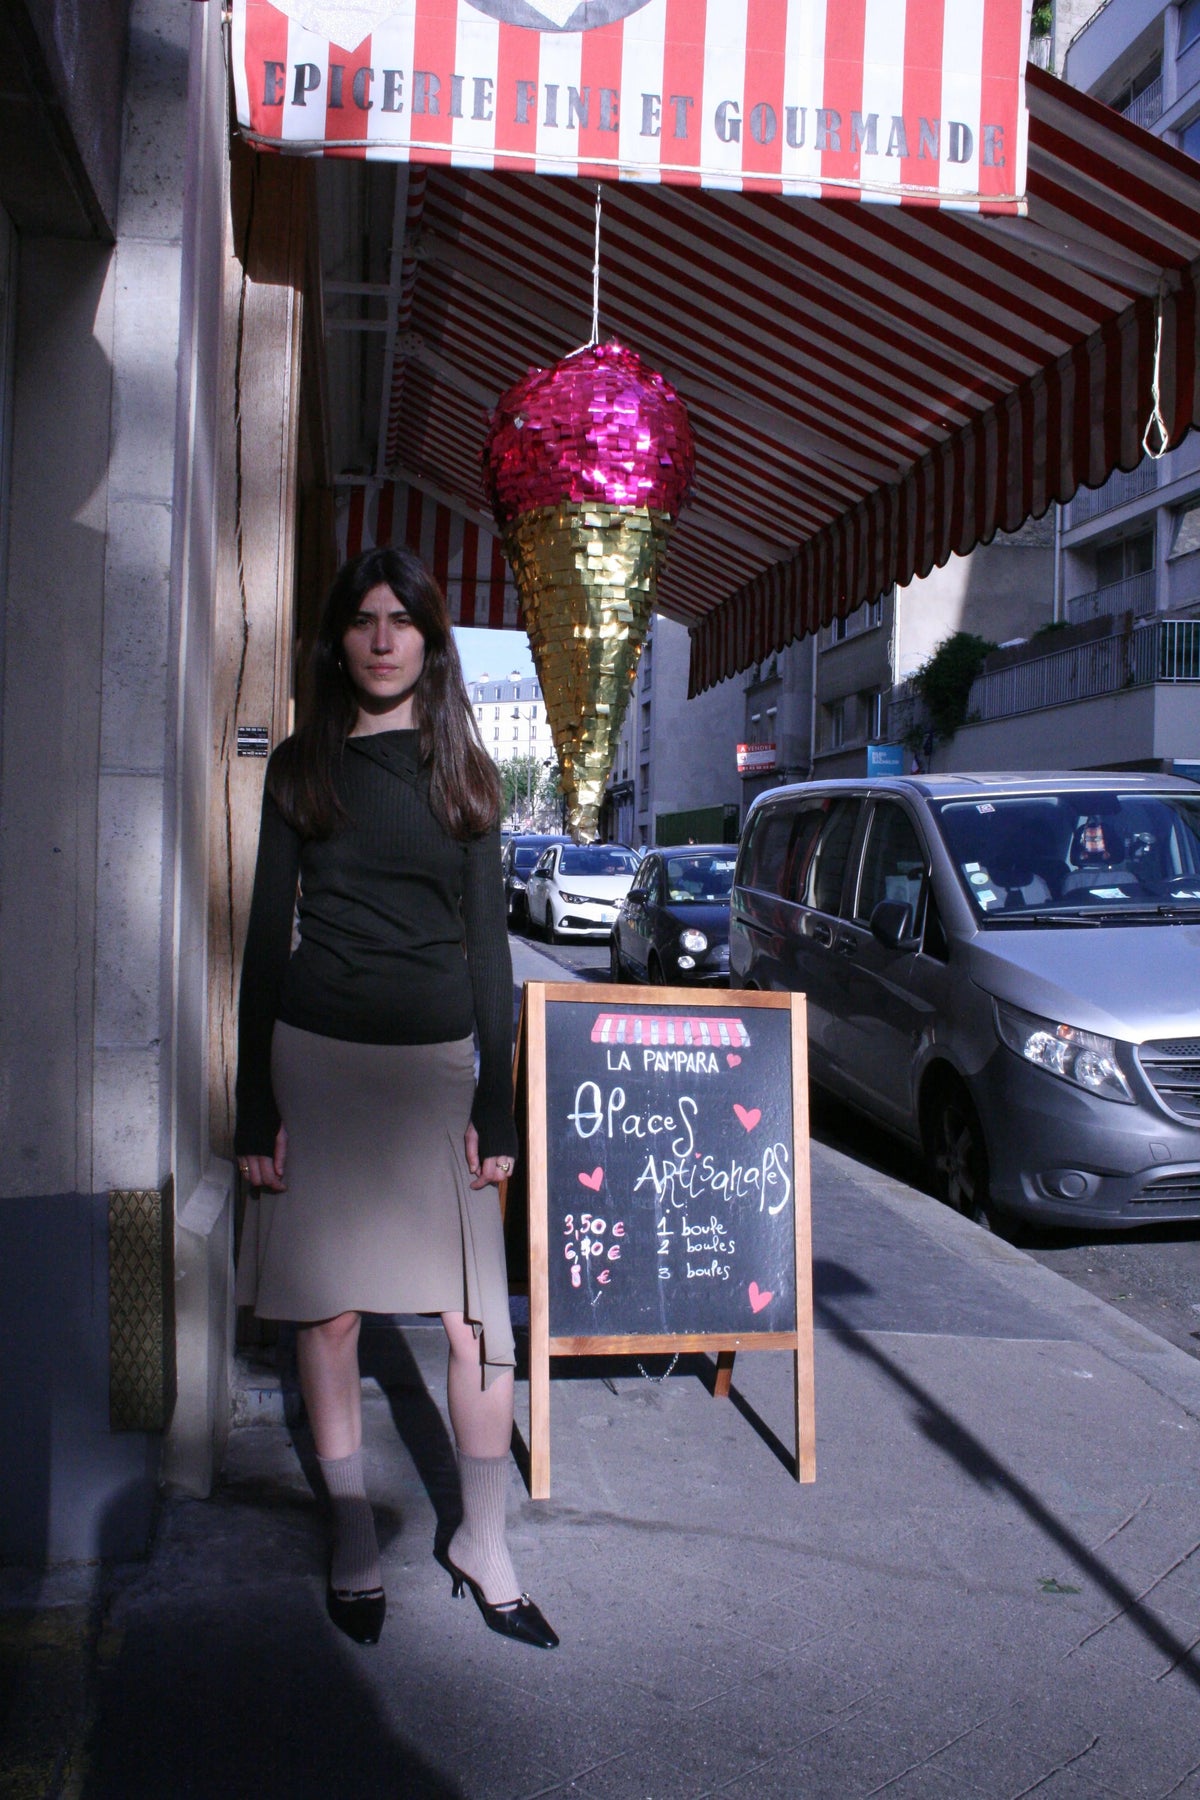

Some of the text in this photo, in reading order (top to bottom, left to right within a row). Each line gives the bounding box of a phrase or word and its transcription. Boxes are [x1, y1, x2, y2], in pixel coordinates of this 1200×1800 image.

[262, 60, 1006, 168] EPICERIE FINE ET GOURMANDE
[606, 1049, 720, 1074] LA PAMPARA
[656, 1216, 674, 1235] 1
[681, 1215, 728, 1236] boule
[656, 1239, 670, 1255] 2
[686, 1236, 736, 1255] boules
[658, 1267, 672, 1280] 3
[686, 1260, 731, 1281] boules
